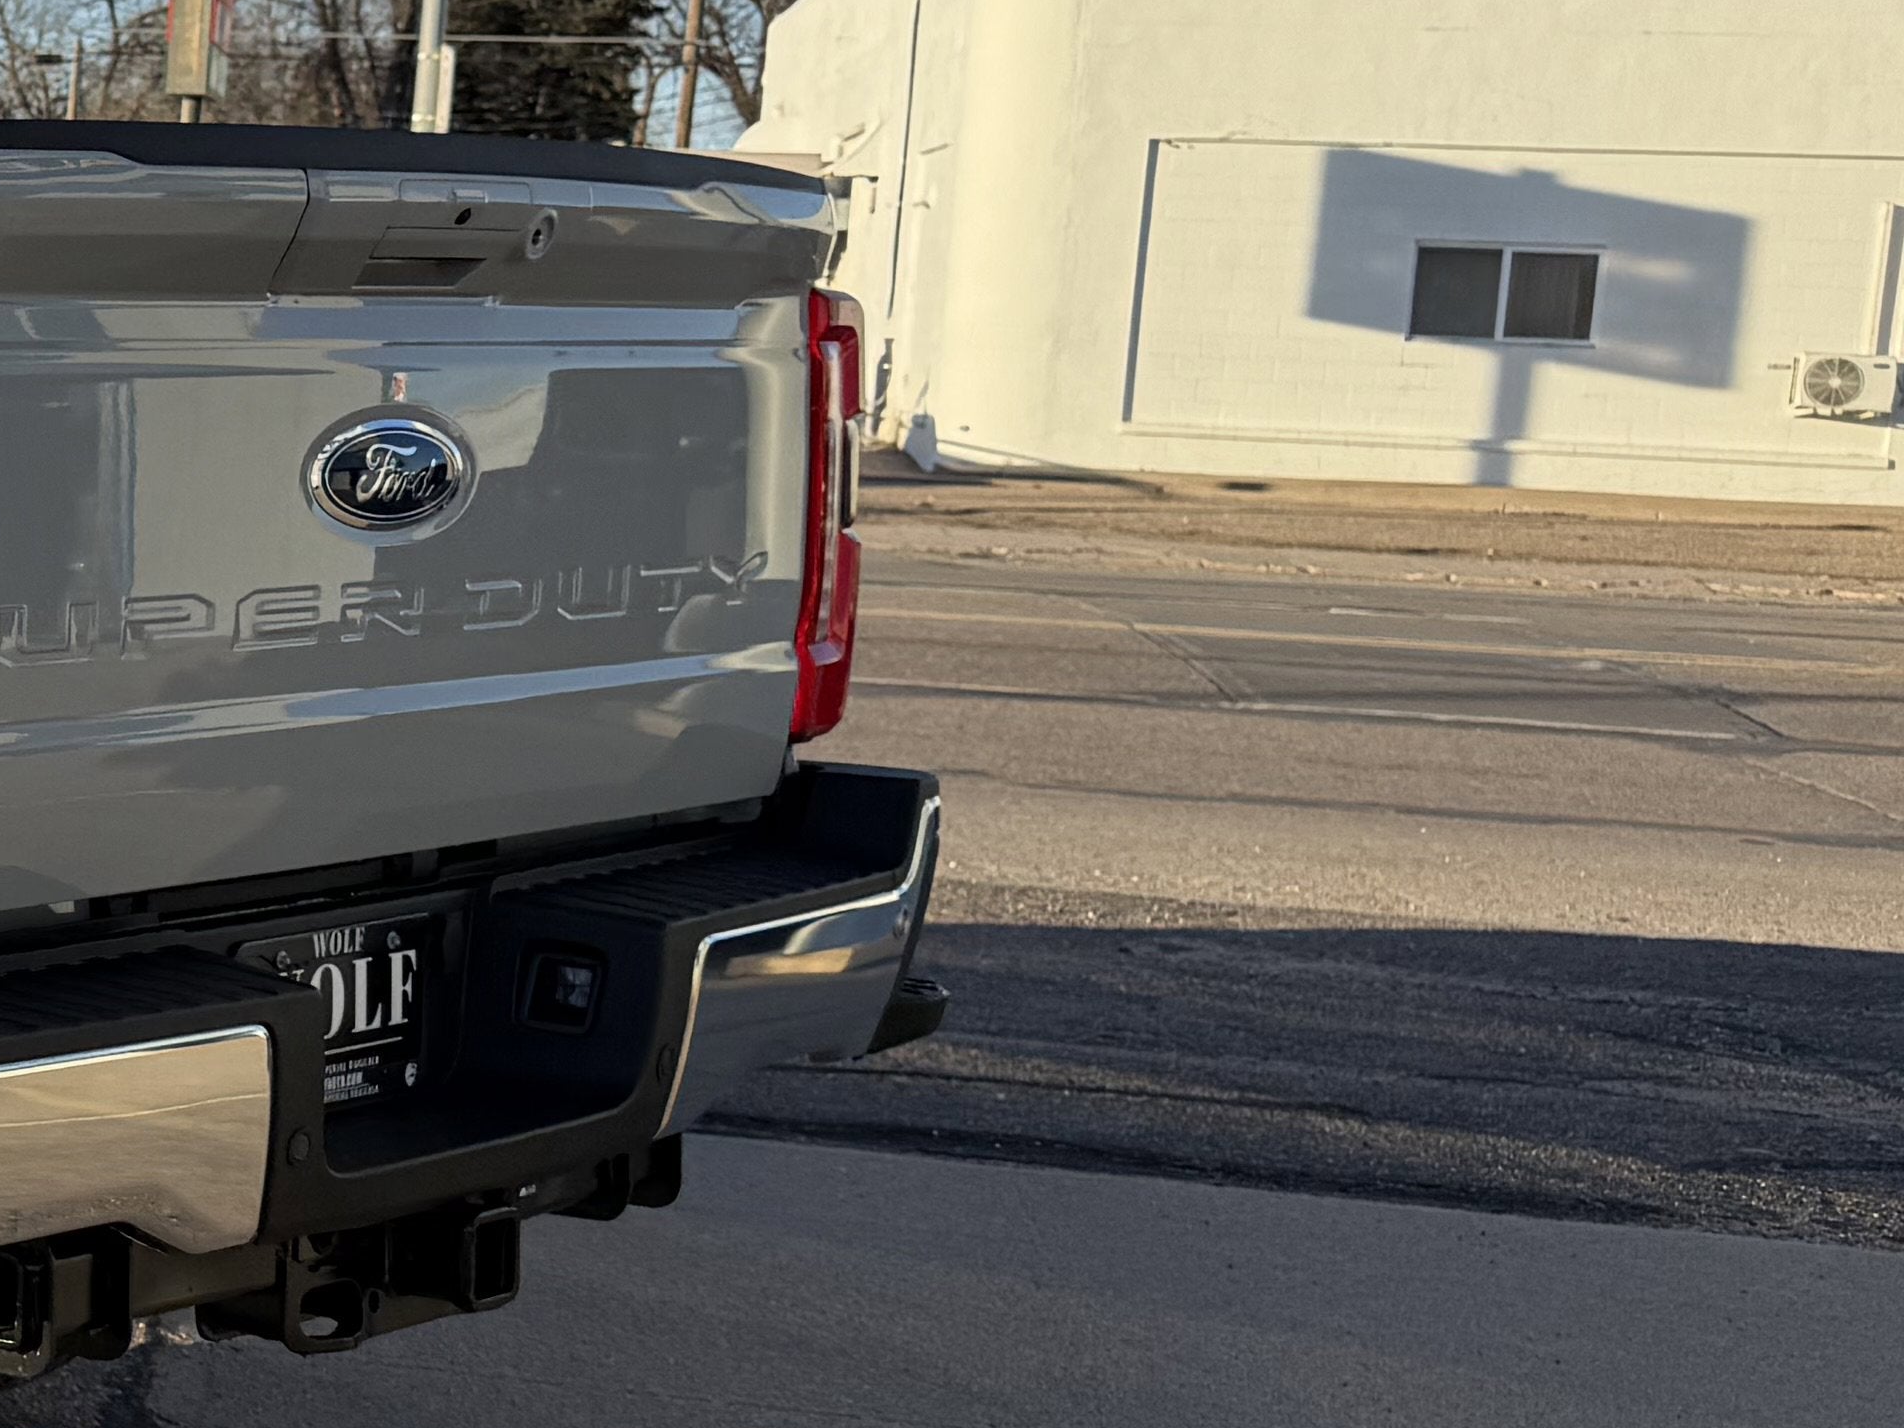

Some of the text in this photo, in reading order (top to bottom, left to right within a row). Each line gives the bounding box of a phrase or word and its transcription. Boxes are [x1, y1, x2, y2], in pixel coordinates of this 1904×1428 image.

[356, 443, 436, 504] Ford
[463, 550, 769, 632] DUTY
[312, 926, 366, 959] WOLF
[278, 948, 418, 1041] OLF
